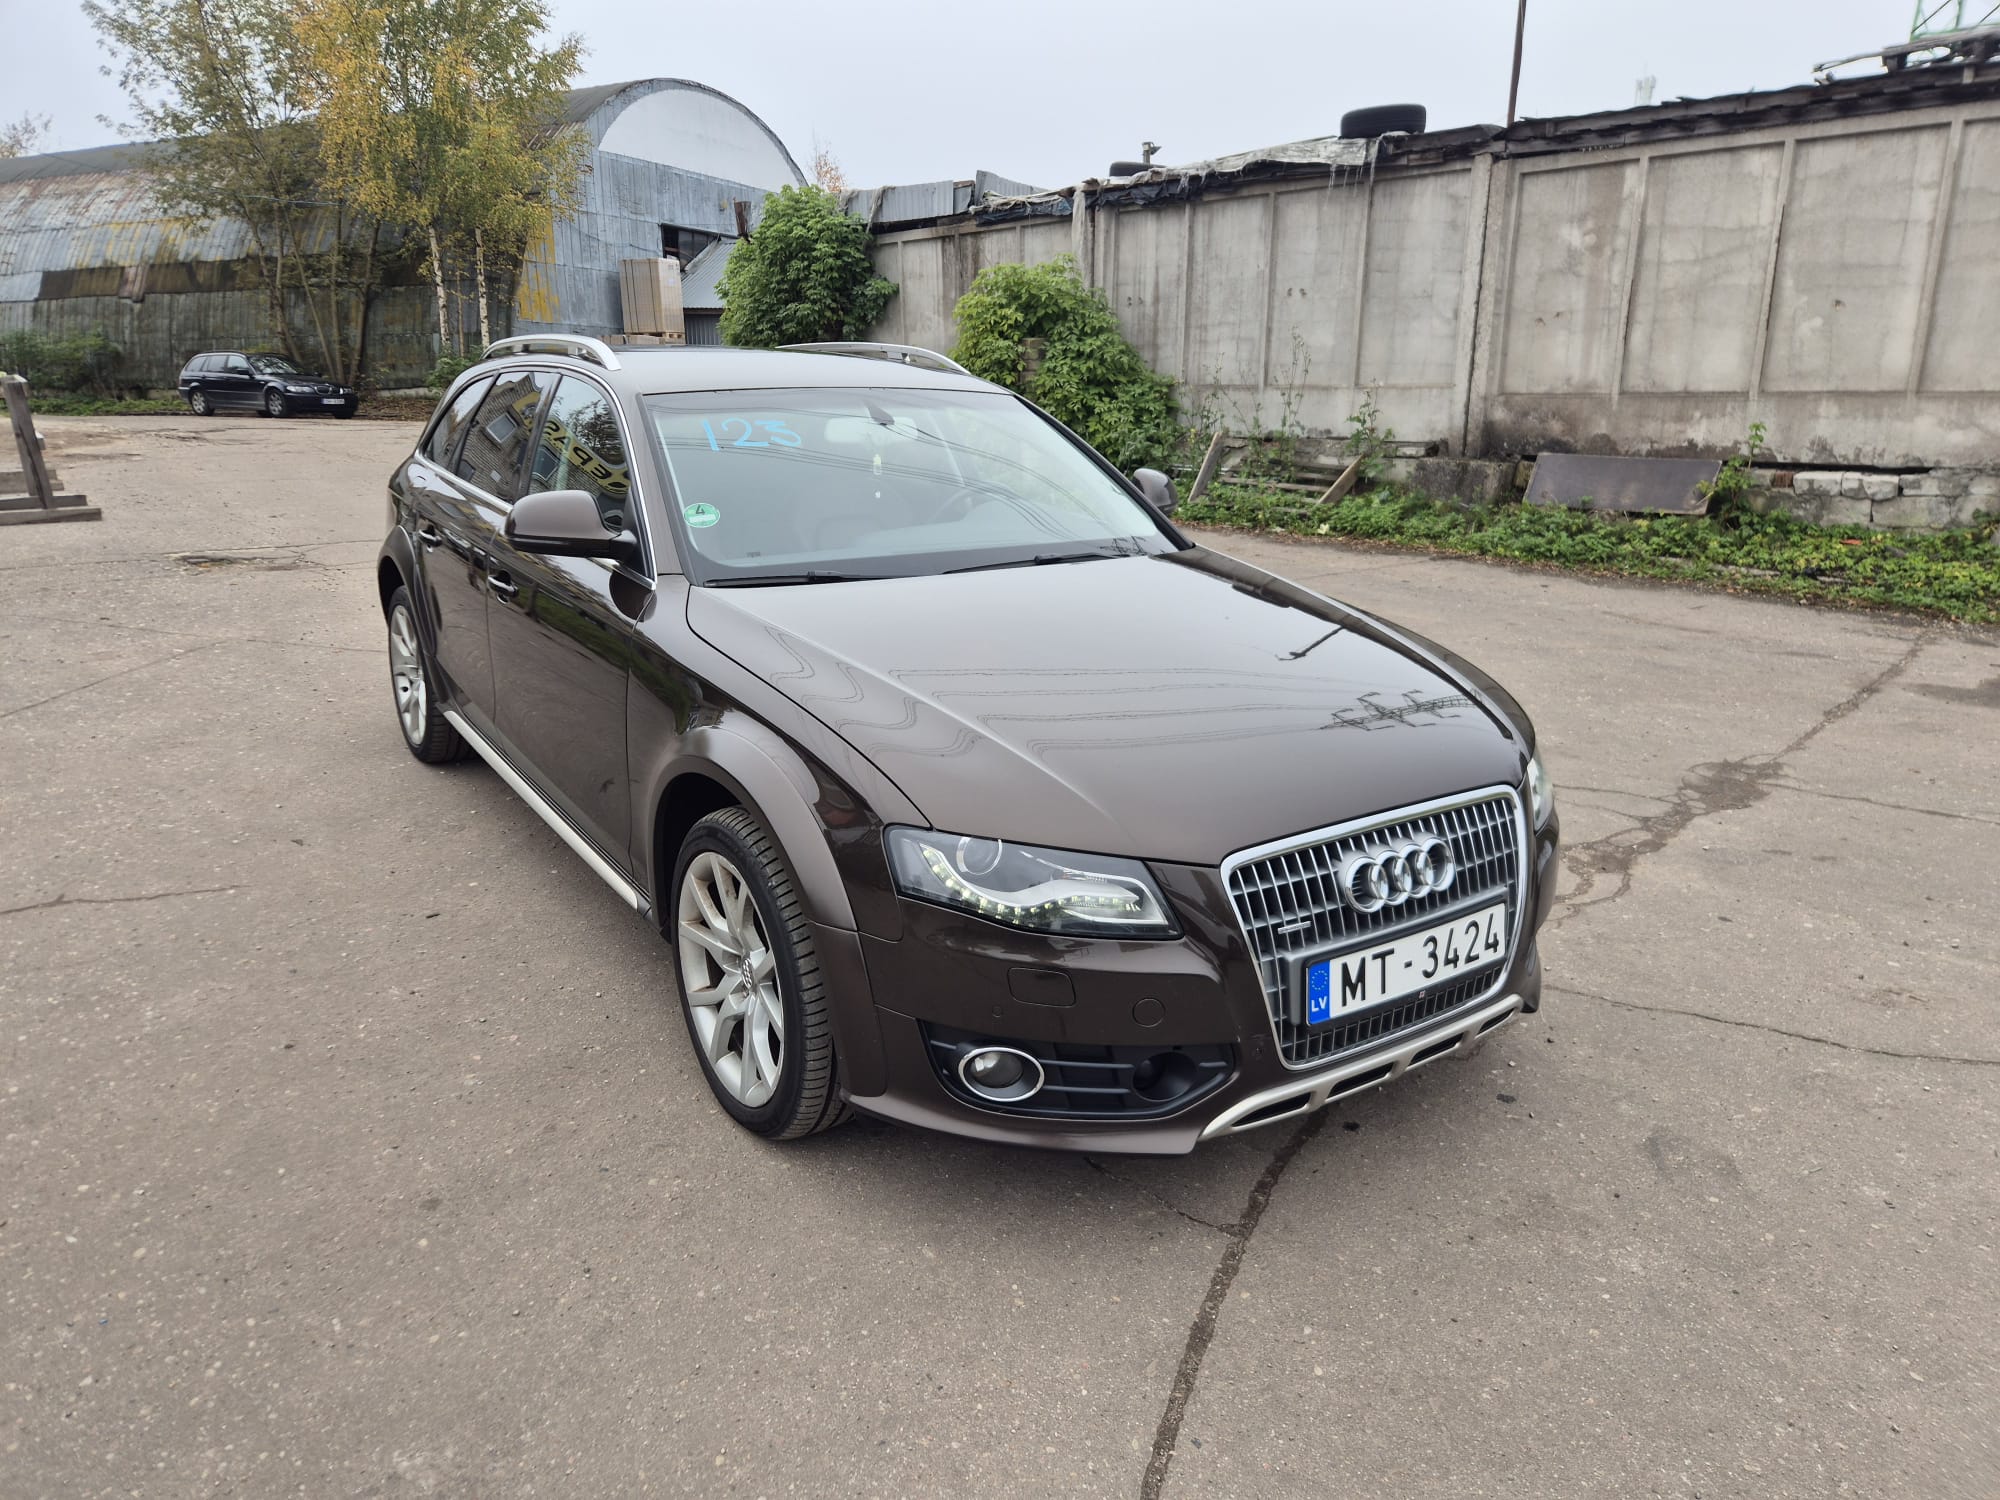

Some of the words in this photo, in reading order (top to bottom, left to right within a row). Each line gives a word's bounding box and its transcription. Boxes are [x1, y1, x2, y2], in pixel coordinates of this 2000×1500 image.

[703, 418, 802, 451] 123
[695, 503, 706, 515] 4
[1340, 913, 1500, 1007] MT-3424
[1310, 995, 1328, 1012] LV
